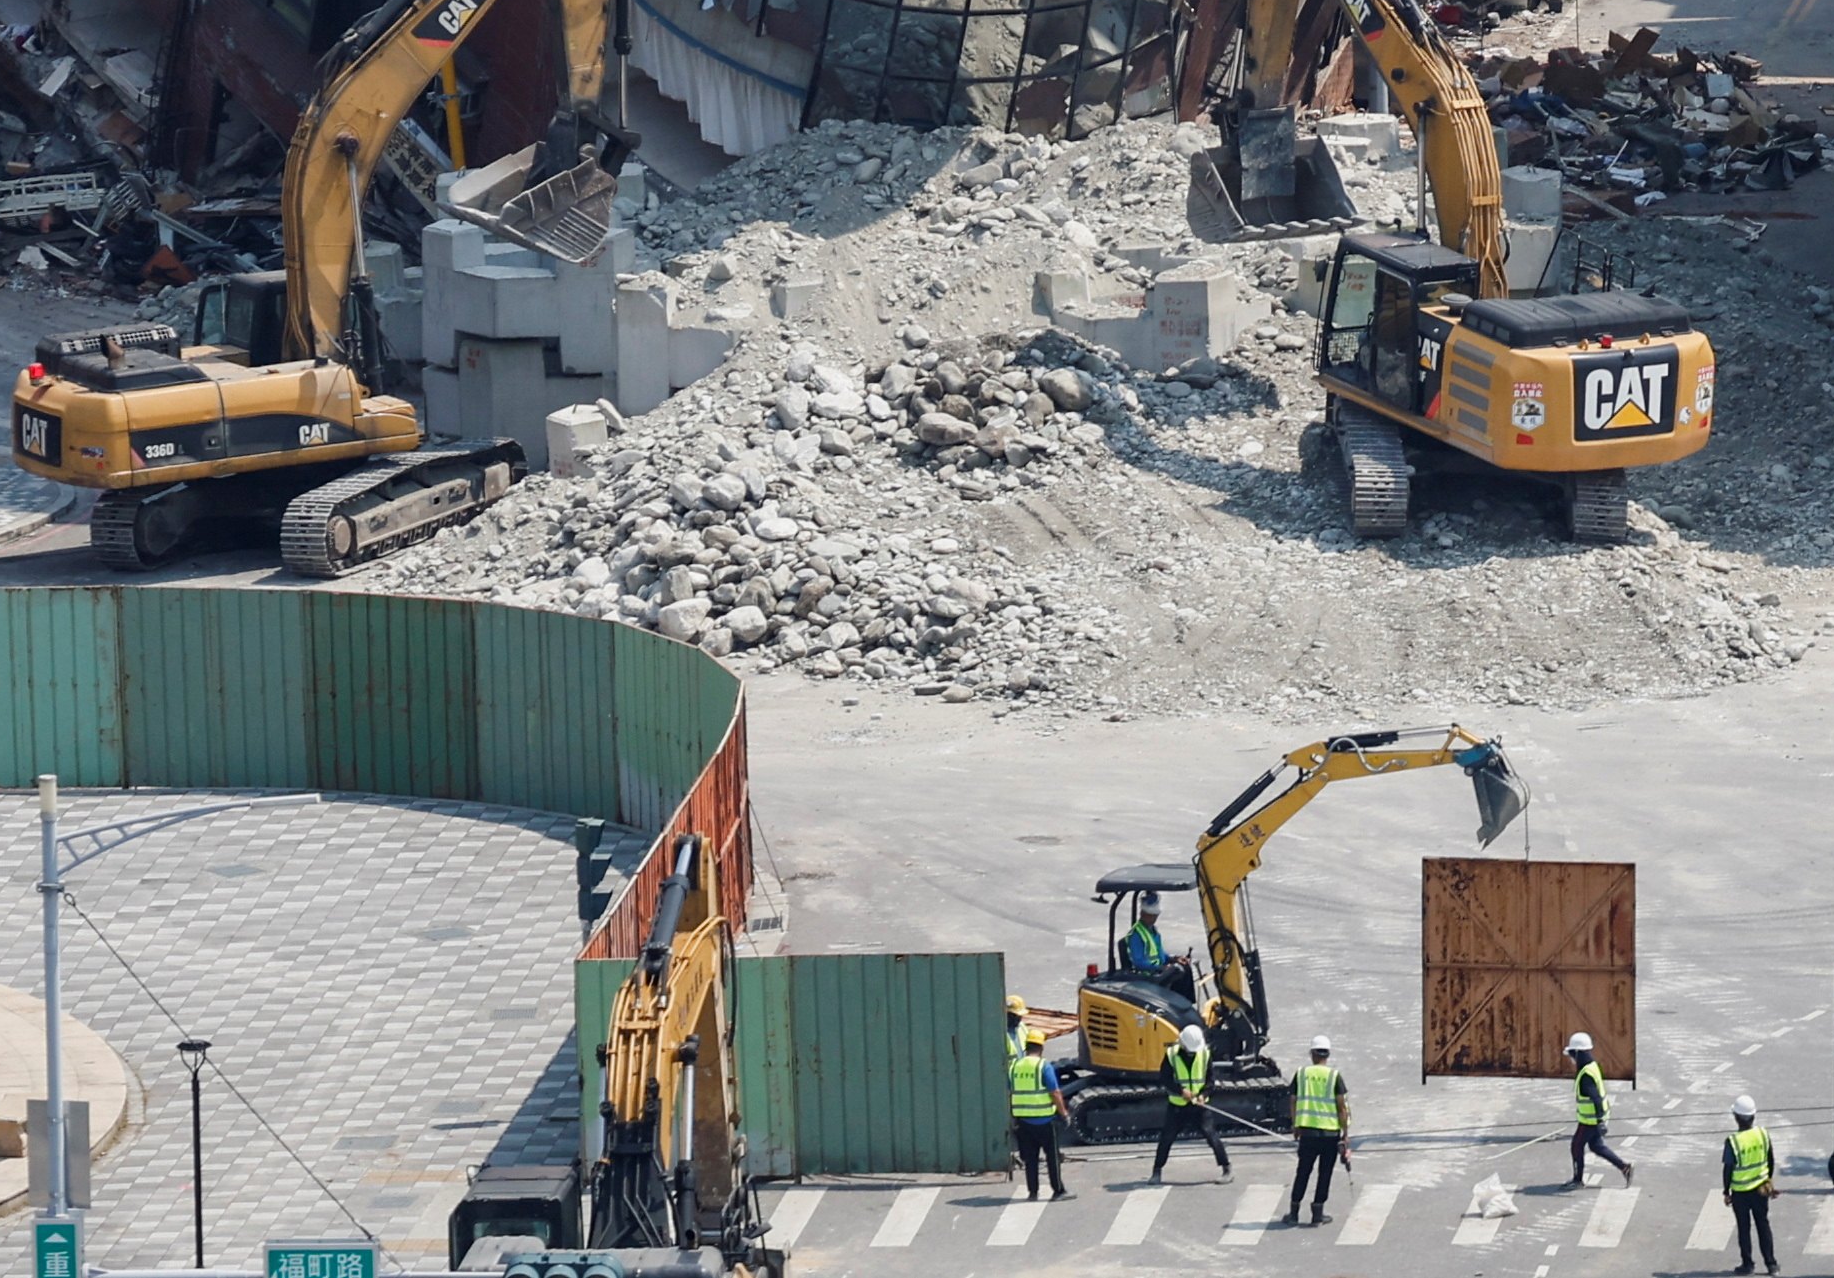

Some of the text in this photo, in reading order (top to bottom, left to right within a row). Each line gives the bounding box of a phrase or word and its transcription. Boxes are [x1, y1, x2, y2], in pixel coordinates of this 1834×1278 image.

[1418, 335, 1441, 371] AT
[1584, 362, 1669, 431] CAT
[22, 412, 48, 457] CAT
[298, 423, 331, 445] CAT
[145, 442, 175, 459] 336D
[279, 1253, 364, 1278] 福町路
